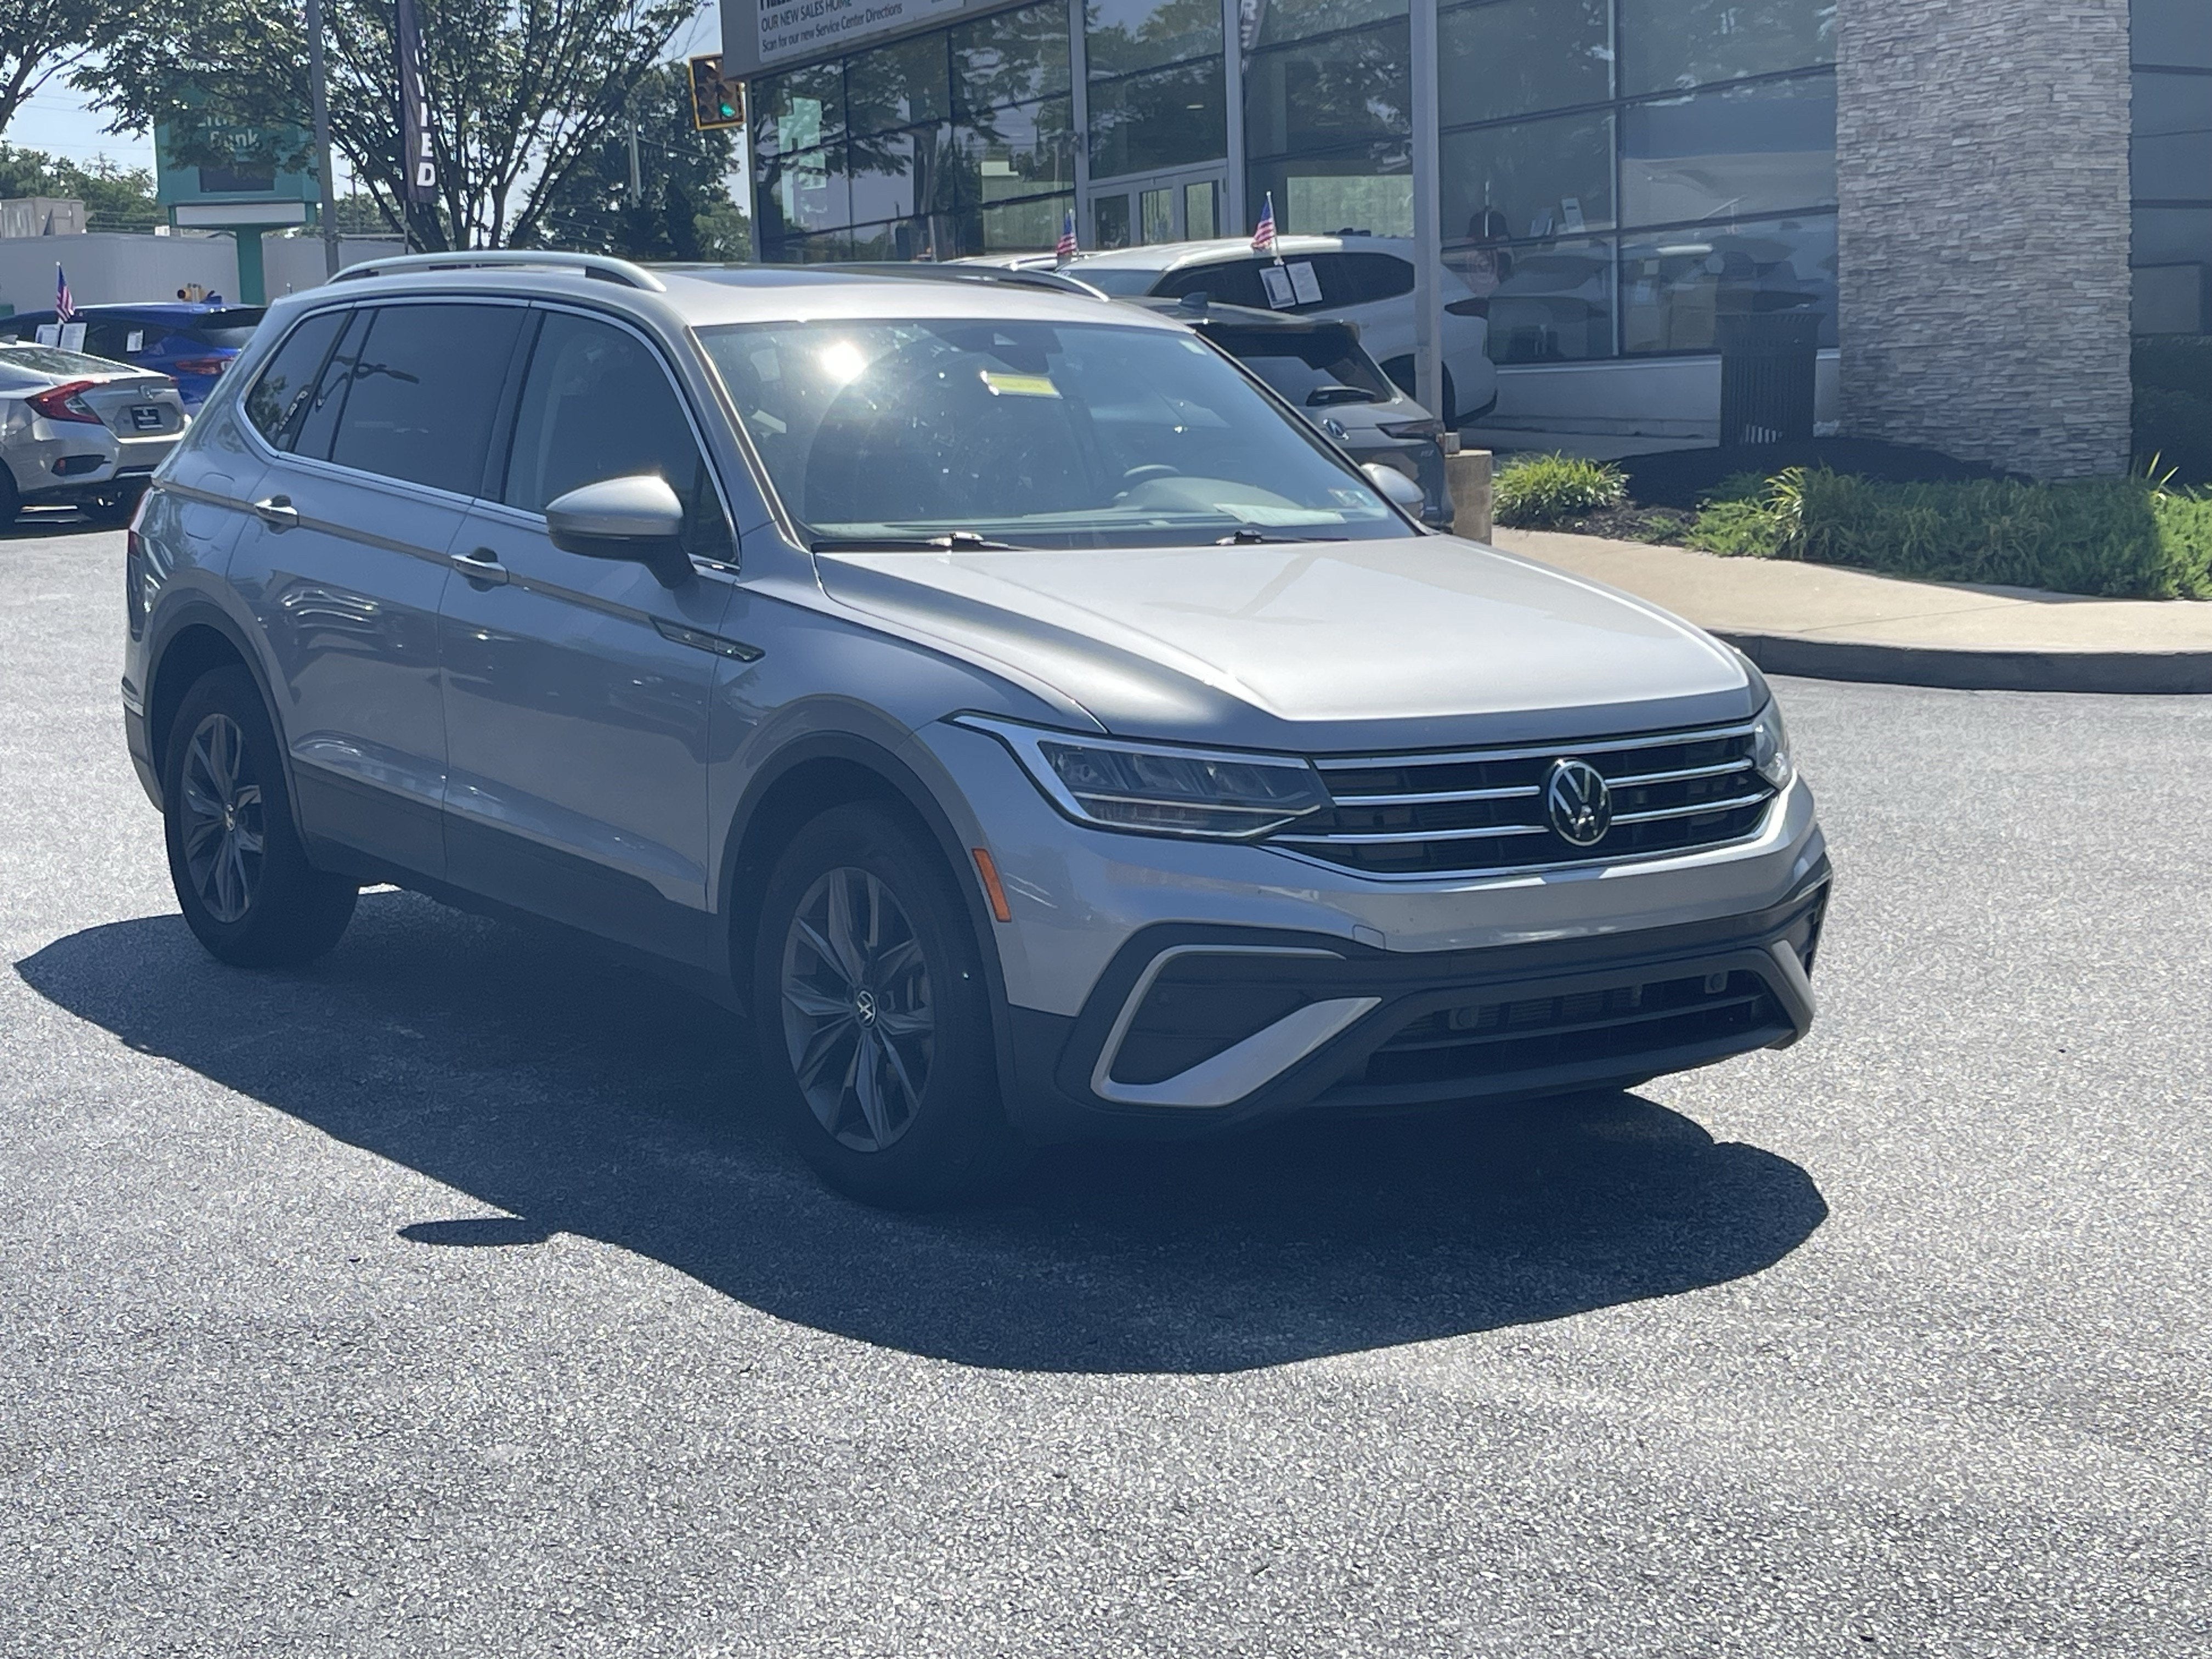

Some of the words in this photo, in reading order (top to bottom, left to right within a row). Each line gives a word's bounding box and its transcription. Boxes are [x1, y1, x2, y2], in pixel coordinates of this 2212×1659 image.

[761, 14, 778, 32] OUR
[780, 8, 799, 27] NEW
[800, 1, 824, 21] SALES
[762, 39, 777, 53] Scan
[778, 34, 787, 47] for
[788, 33, 799, 46] our
[800, 30, 815, 42] new
[815, 20, 840, 38] Service
[841, 13, 865, 30] Center
[866, 3, 902, 23] Directions
